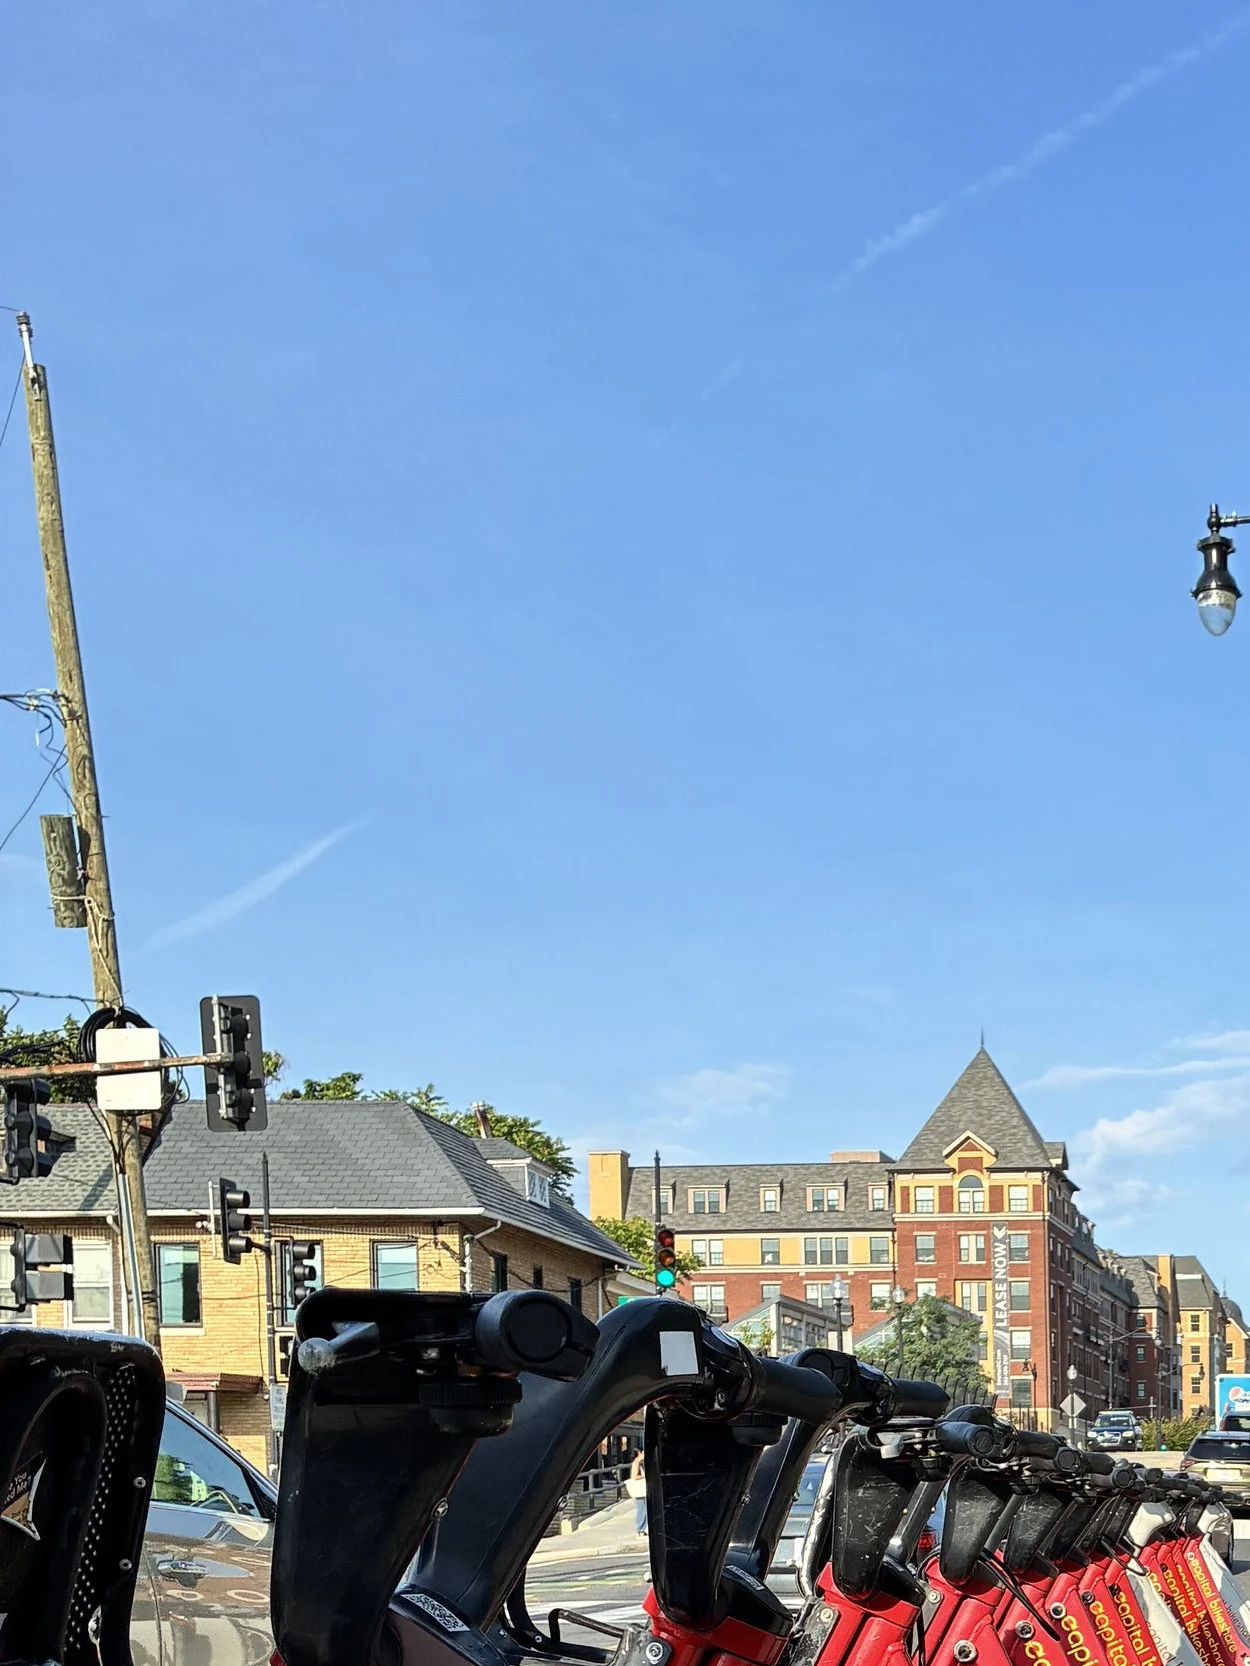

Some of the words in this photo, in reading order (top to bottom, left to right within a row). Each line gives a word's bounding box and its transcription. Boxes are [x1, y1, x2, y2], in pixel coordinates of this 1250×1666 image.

[994, 1243, 1007, 1279] NOW
[995, 1283, 1008, 1327] LEASE
[1209, 1597, 1237, 1654] bikeshare
